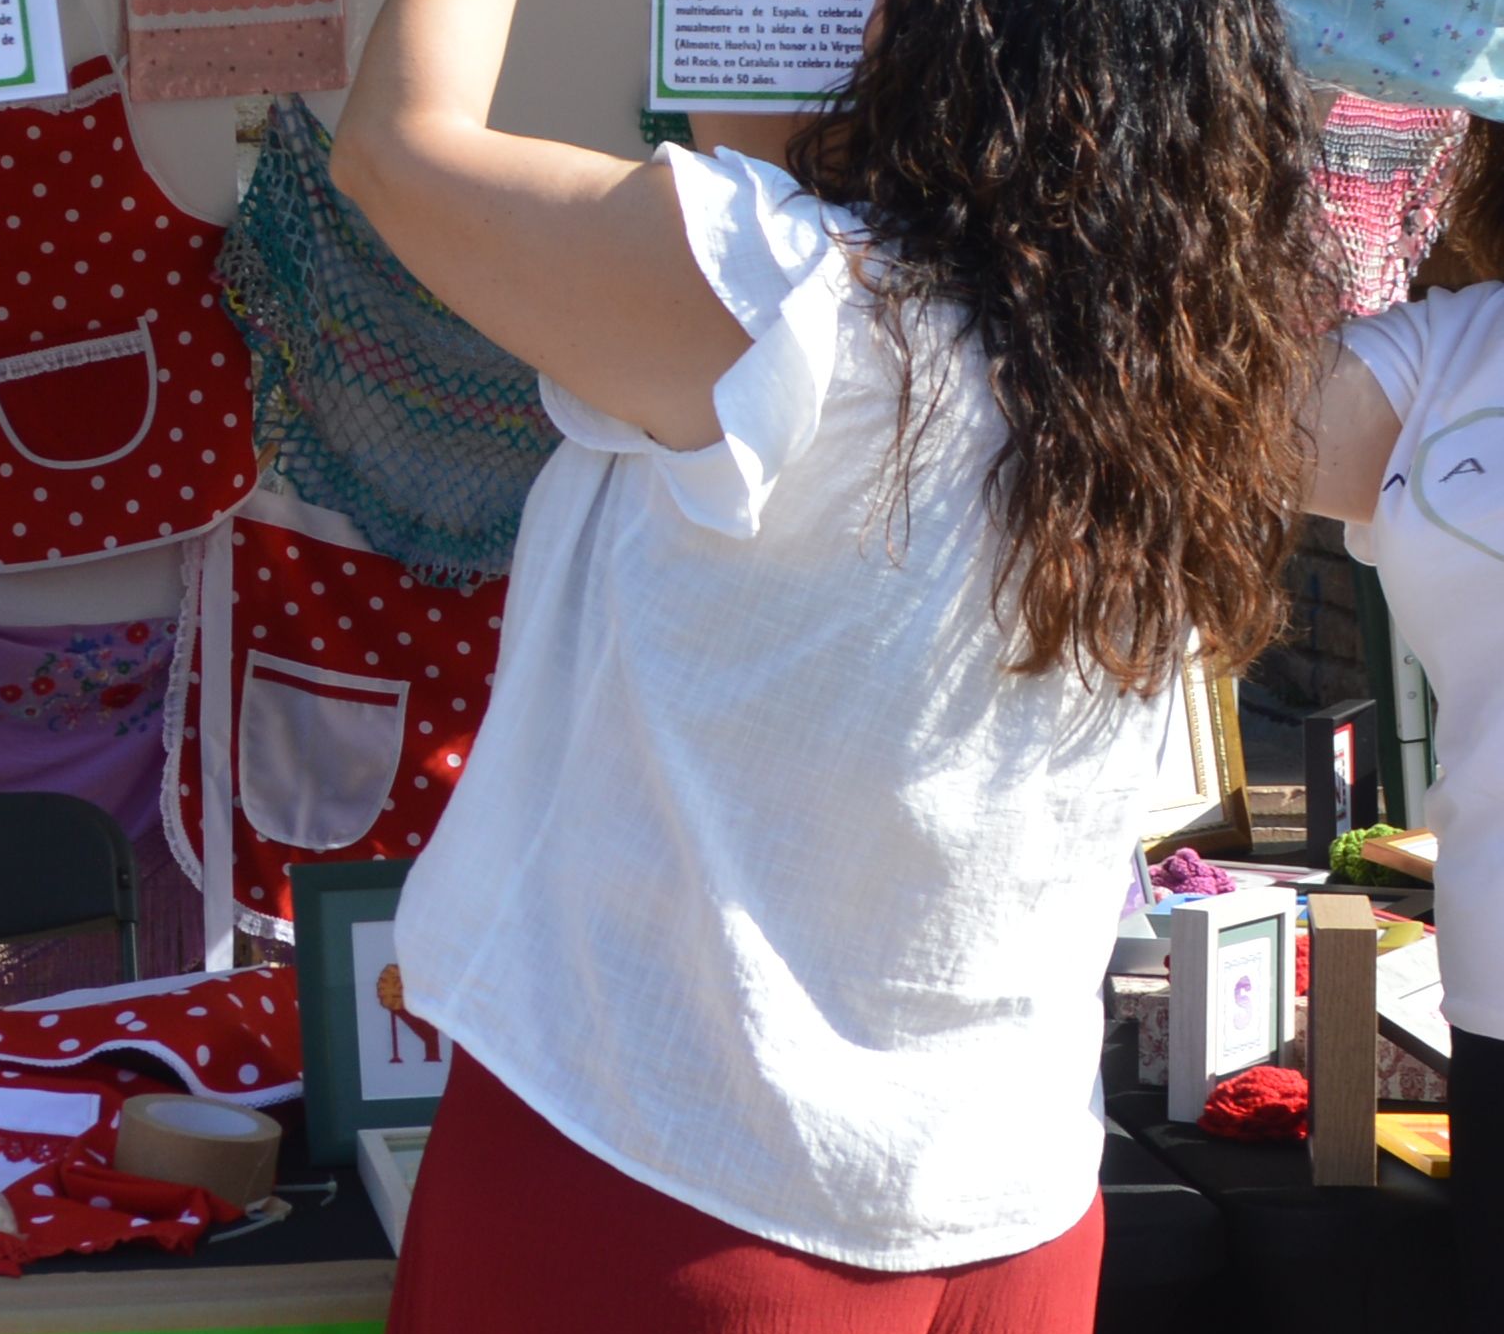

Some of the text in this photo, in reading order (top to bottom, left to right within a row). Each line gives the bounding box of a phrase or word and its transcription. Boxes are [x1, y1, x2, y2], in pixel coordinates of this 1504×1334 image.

[676, 6, 743, 16] multitudinaria
[752, 7, 763, 16] de
[818, 7, 863, 18] celebrada
[675, 23, 731, 33] anualmente
[738, 26, 750, 34] en
[757, 24, 765, 34] la
[771, 24, 795, 34] aldea
[803, 24, 814, 34] de
[820, 24, 829, 34] El
[1, 33, 15, 46] de
[764, 42, 775, 51] en
[780, 41, 807, 52] honor
[811, 44, 816, 52] a
[819, 42, 828, 52] la
[831, 42, 863, 55] Virgen
[675, 57, 689, 67] del
[724, 59, 736, 67] en
[739, 57, 780, 68] Cataluña
[783, 60, 793, 68] se
[797, 58, 831, 68] celebra
[835, 58, 860, 68] desd
[675, 74, 696, 84] hace
[699, 74, 719, 84] más
[723, 75, 734, 84] de
[737, 74, 749, 84] 50
